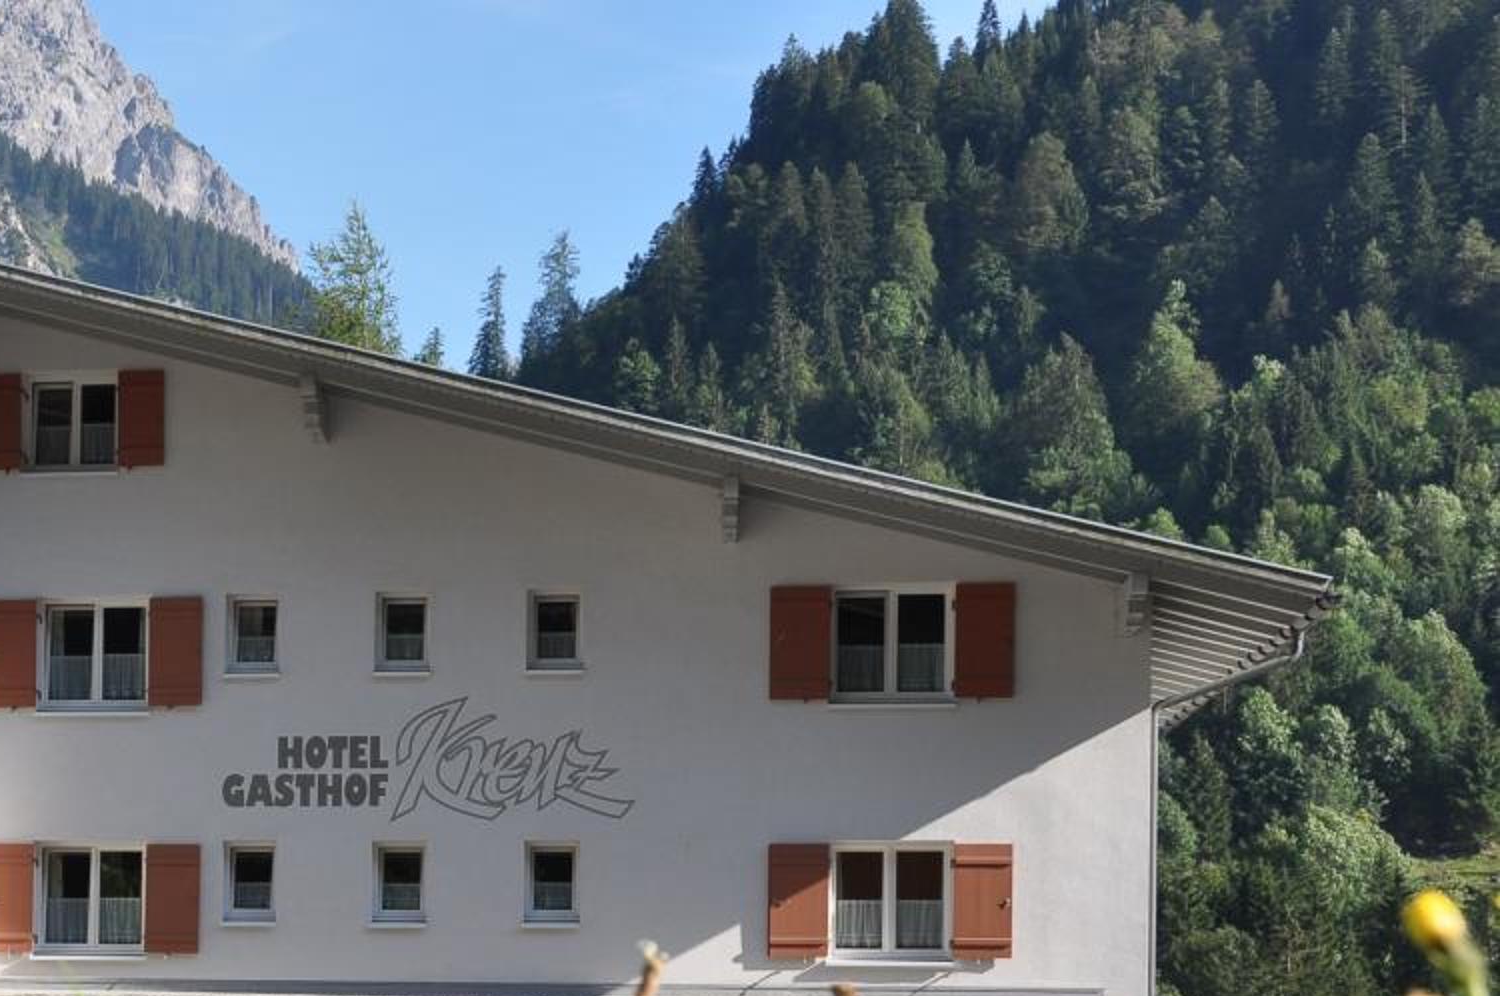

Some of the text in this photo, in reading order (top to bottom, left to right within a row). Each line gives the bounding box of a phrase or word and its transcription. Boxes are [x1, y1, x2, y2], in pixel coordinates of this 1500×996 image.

[277, 736, 388, 768] HOTEL
[390, 697, 636, 821] Kreuz
[222, 773, 388, 807] GASTHOF
